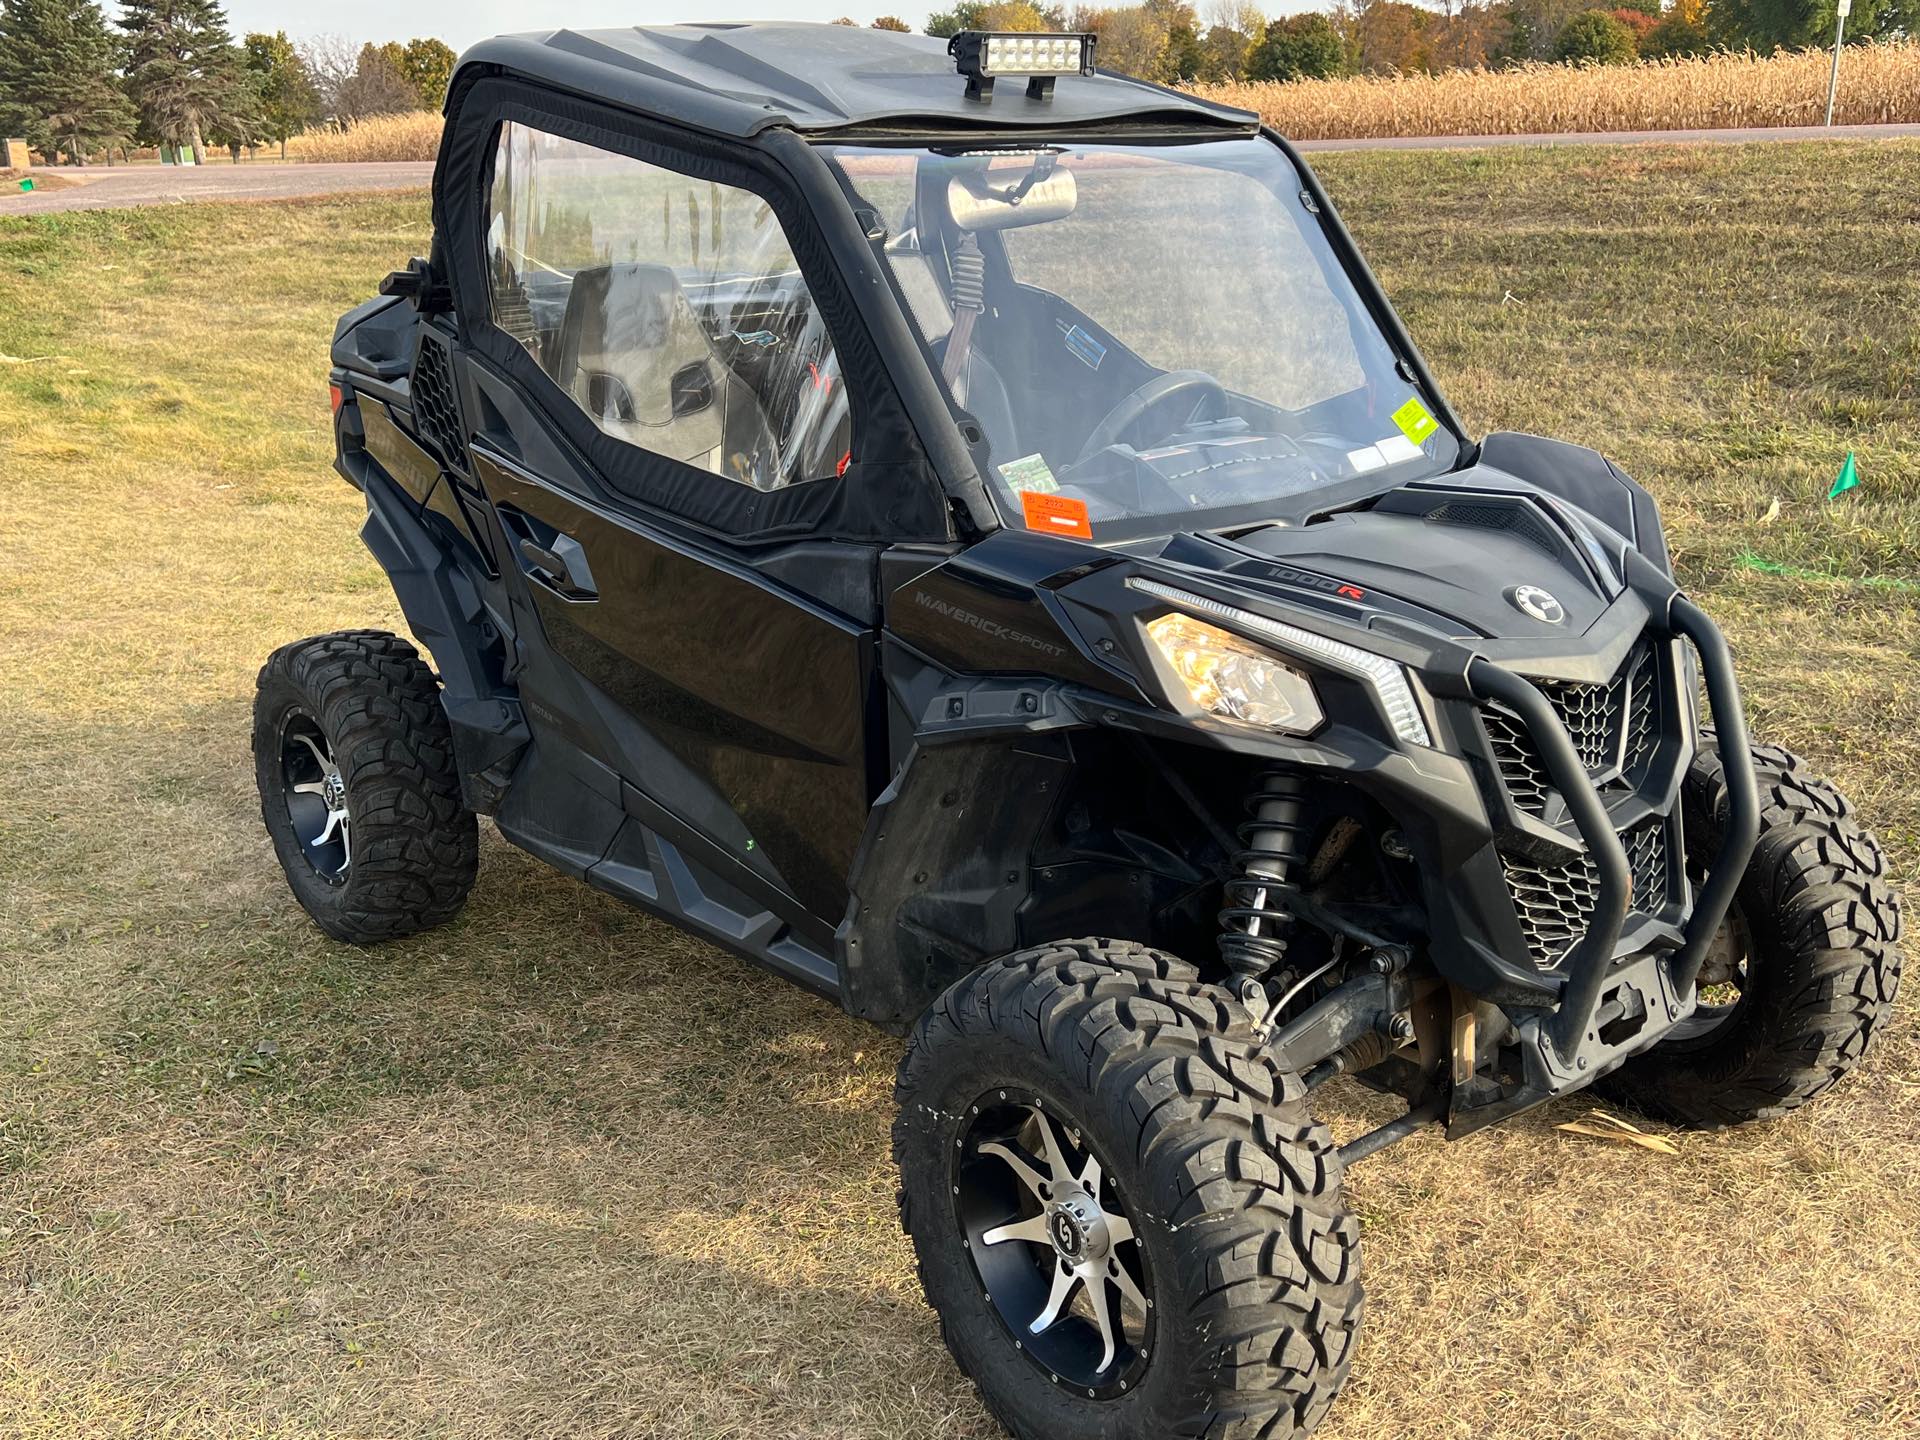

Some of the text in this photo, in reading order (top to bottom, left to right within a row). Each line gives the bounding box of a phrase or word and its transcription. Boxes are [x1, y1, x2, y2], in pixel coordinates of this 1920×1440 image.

[1267, 567, 1365, 601] 1000R
[915, 591, 1065, 656] MAVERICK SPORT
